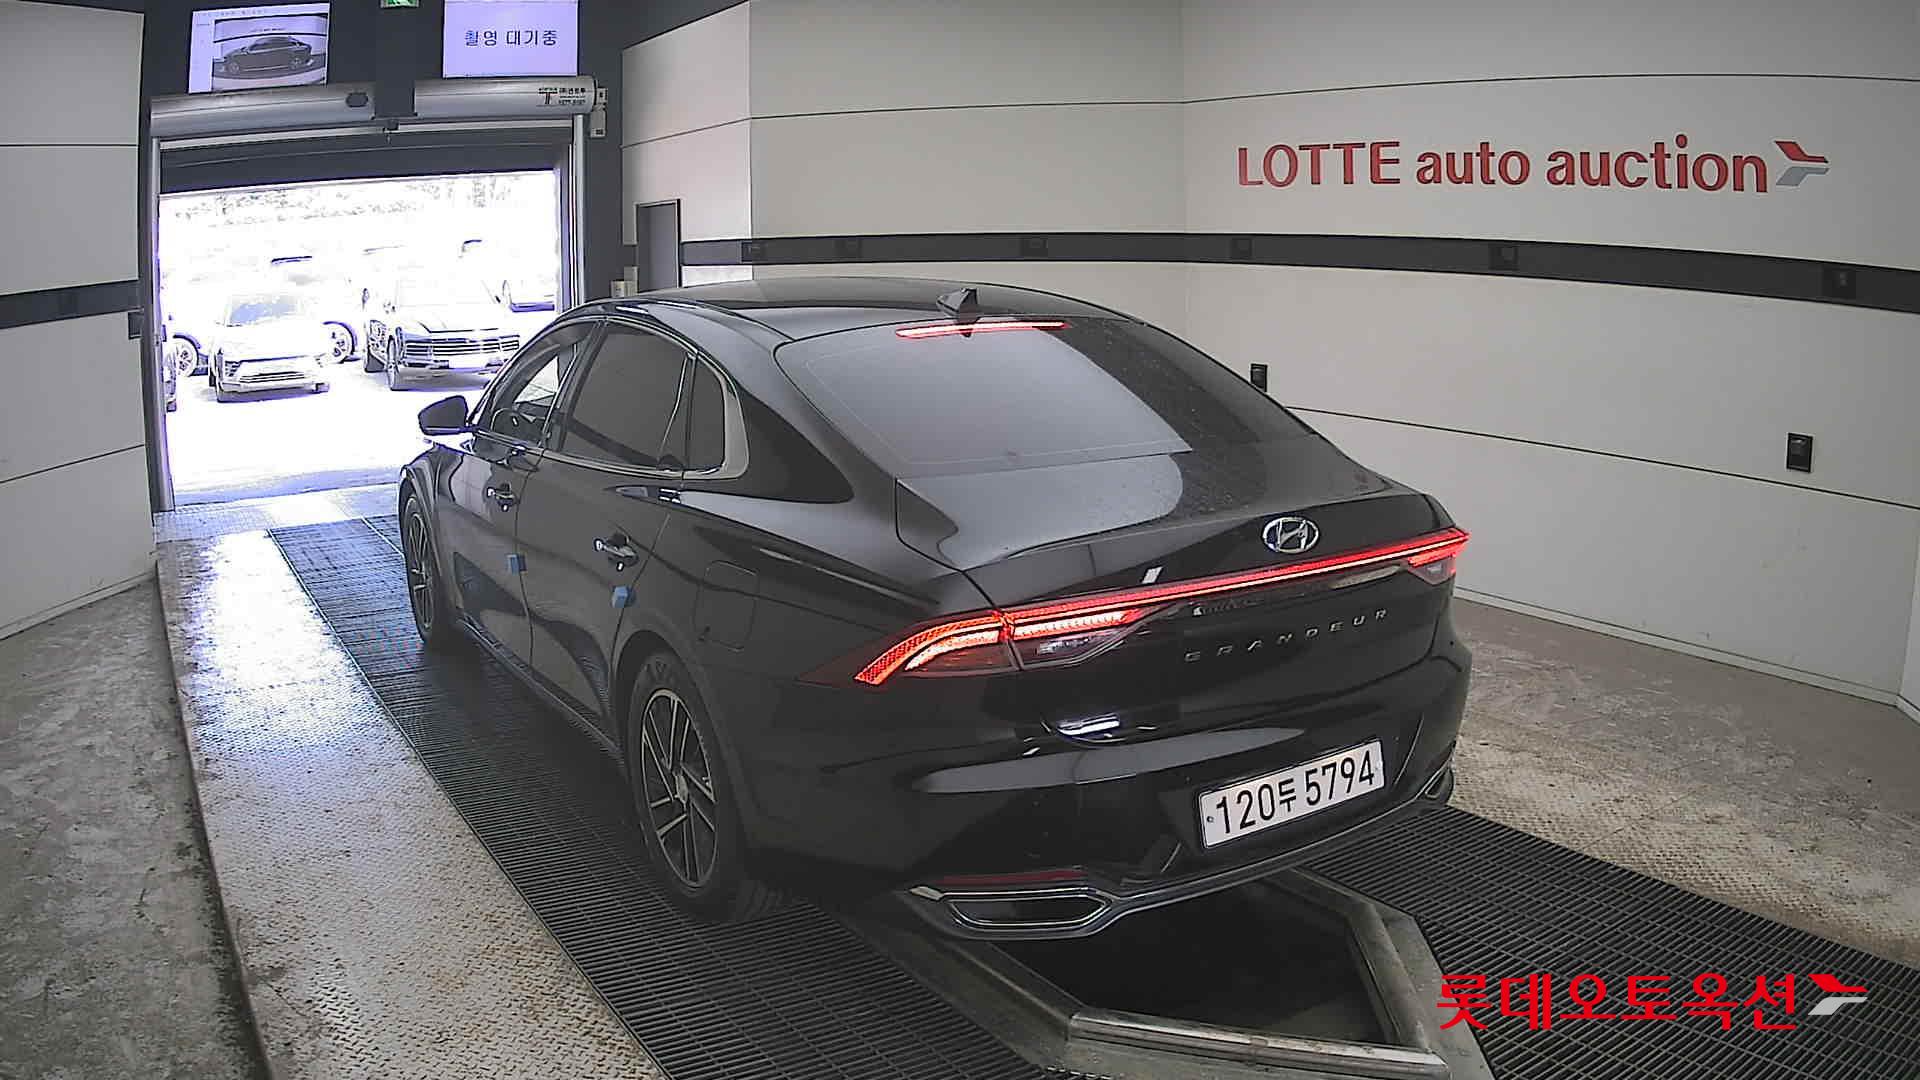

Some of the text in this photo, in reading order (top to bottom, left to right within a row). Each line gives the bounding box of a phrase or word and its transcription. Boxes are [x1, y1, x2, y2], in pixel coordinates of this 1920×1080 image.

[506, 30, 558, 46] 대기중
[1238, 133, 1769, 193] LOTTE auto auction
[1184, 608, 1388, 662] GRANDEUR
